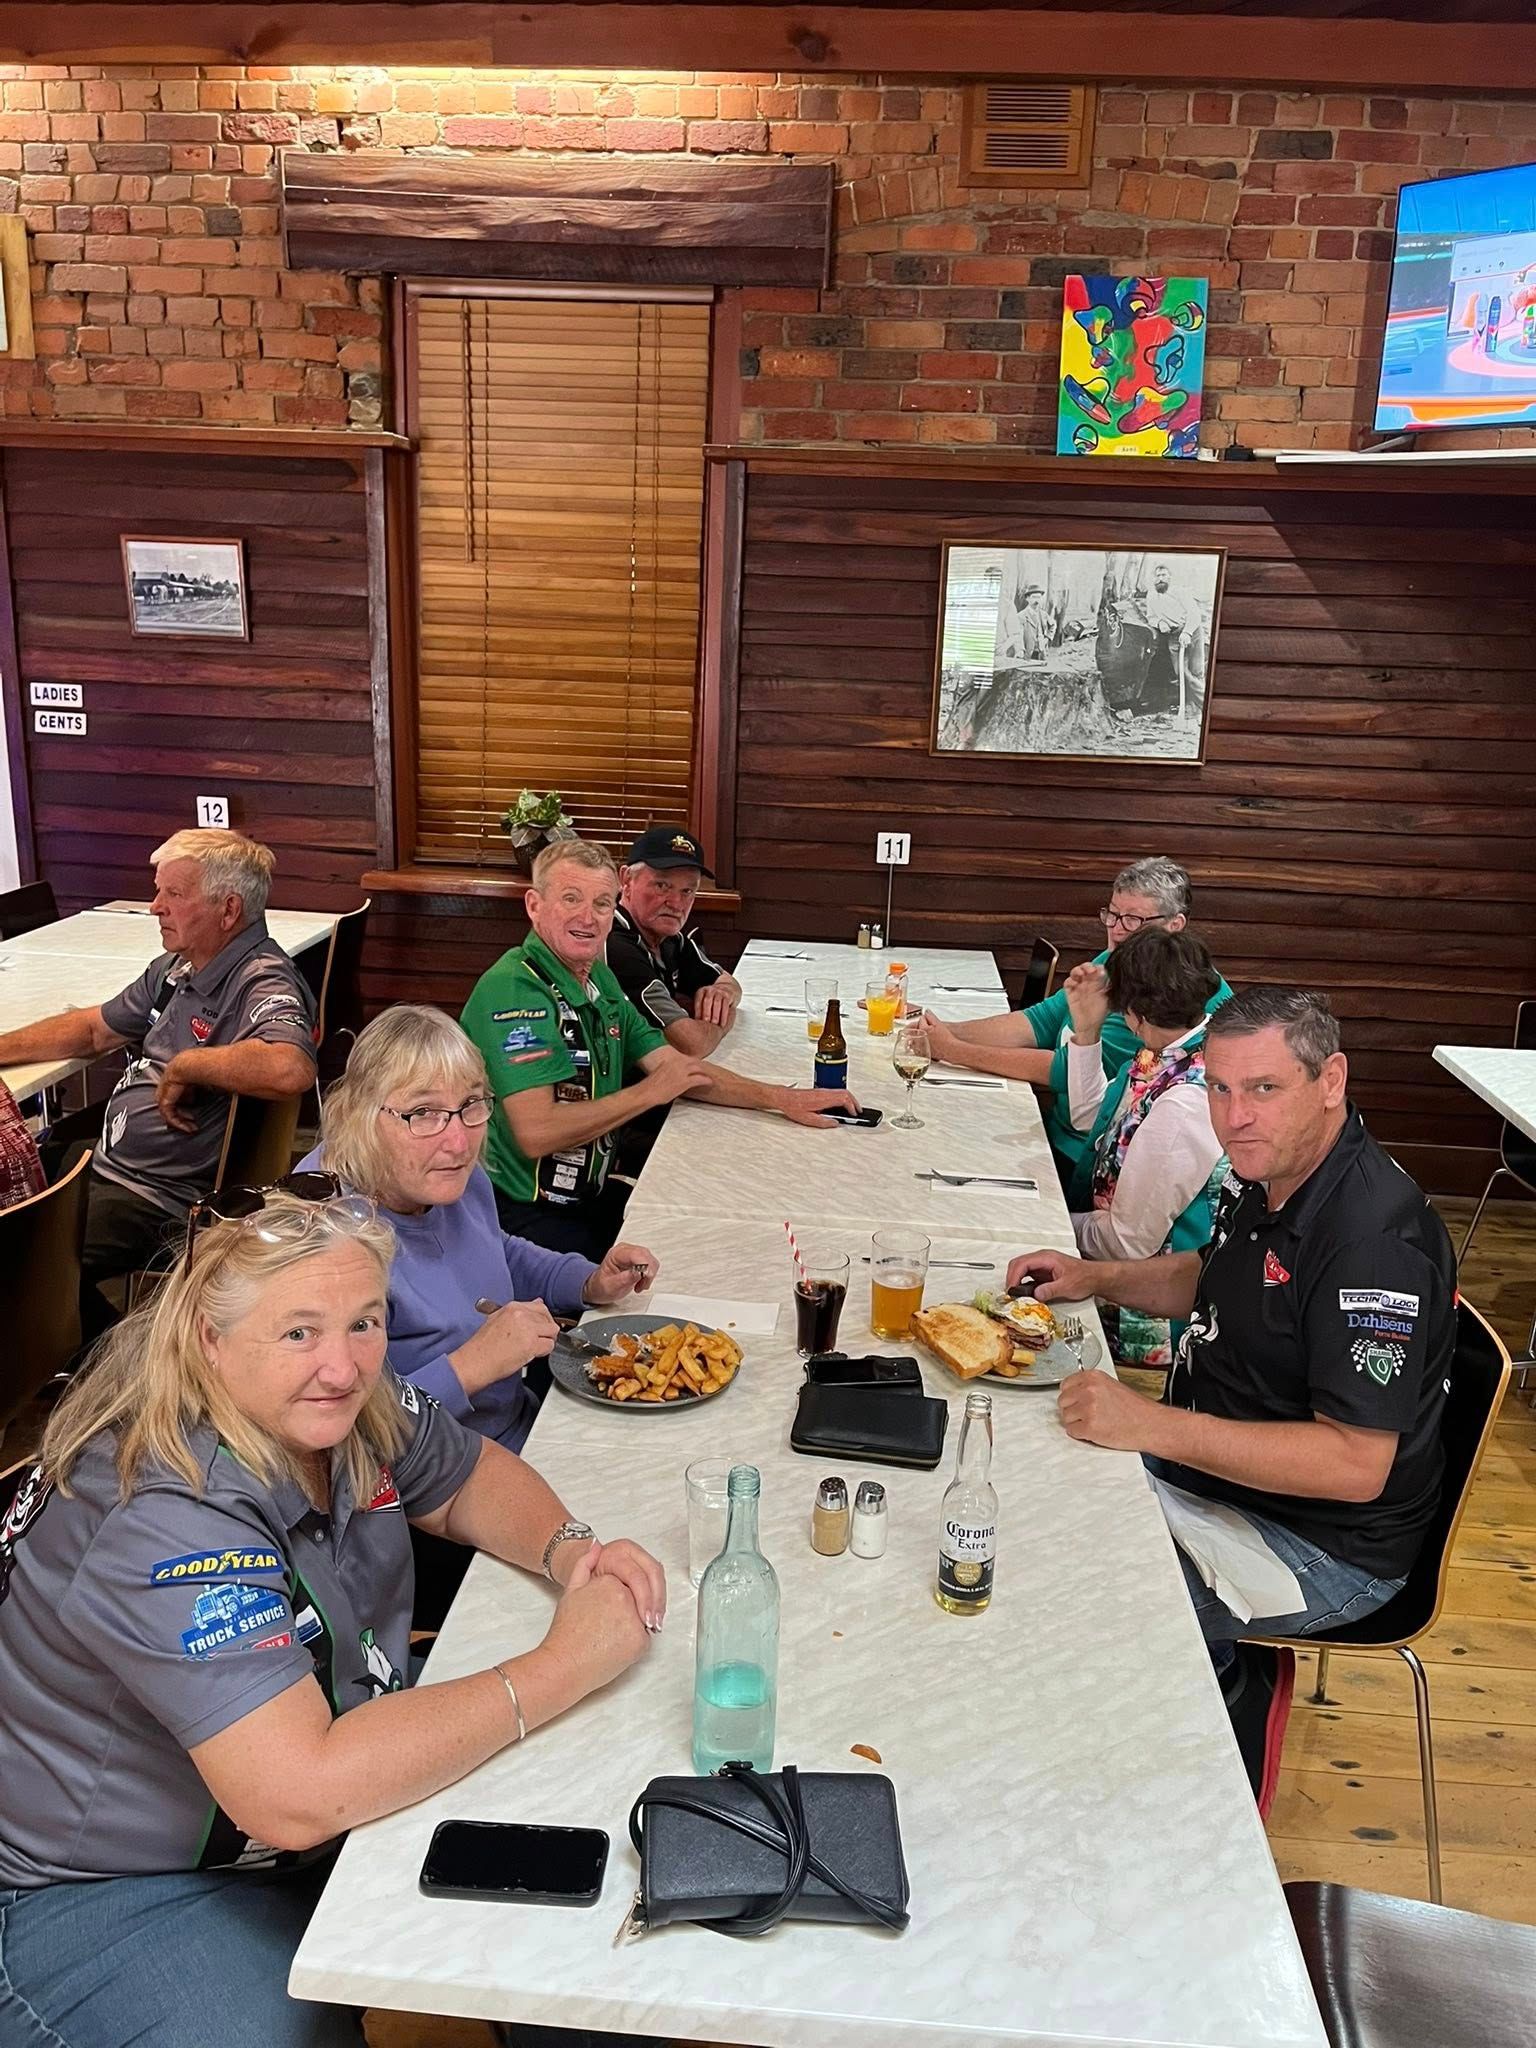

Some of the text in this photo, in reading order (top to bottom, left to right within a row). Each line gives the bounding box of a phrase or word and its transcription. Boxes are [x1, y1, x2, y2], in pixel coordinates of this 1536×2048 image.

[34, 686, 78, 701] LADIES
[39, 714, 82, 730] GENTS
[203, 802, 223, 823] 12
[884, 838, 904, 859] 11
[1346, 1313, 1413, 1333] Dahlsens
[946, 1521, 996, 1539] Corona
[958, 1538, 986, 1550] Extra
[187, 1624, 237, 1655] TRUCK
[238, 1603, 286, 1633] SERVICE
